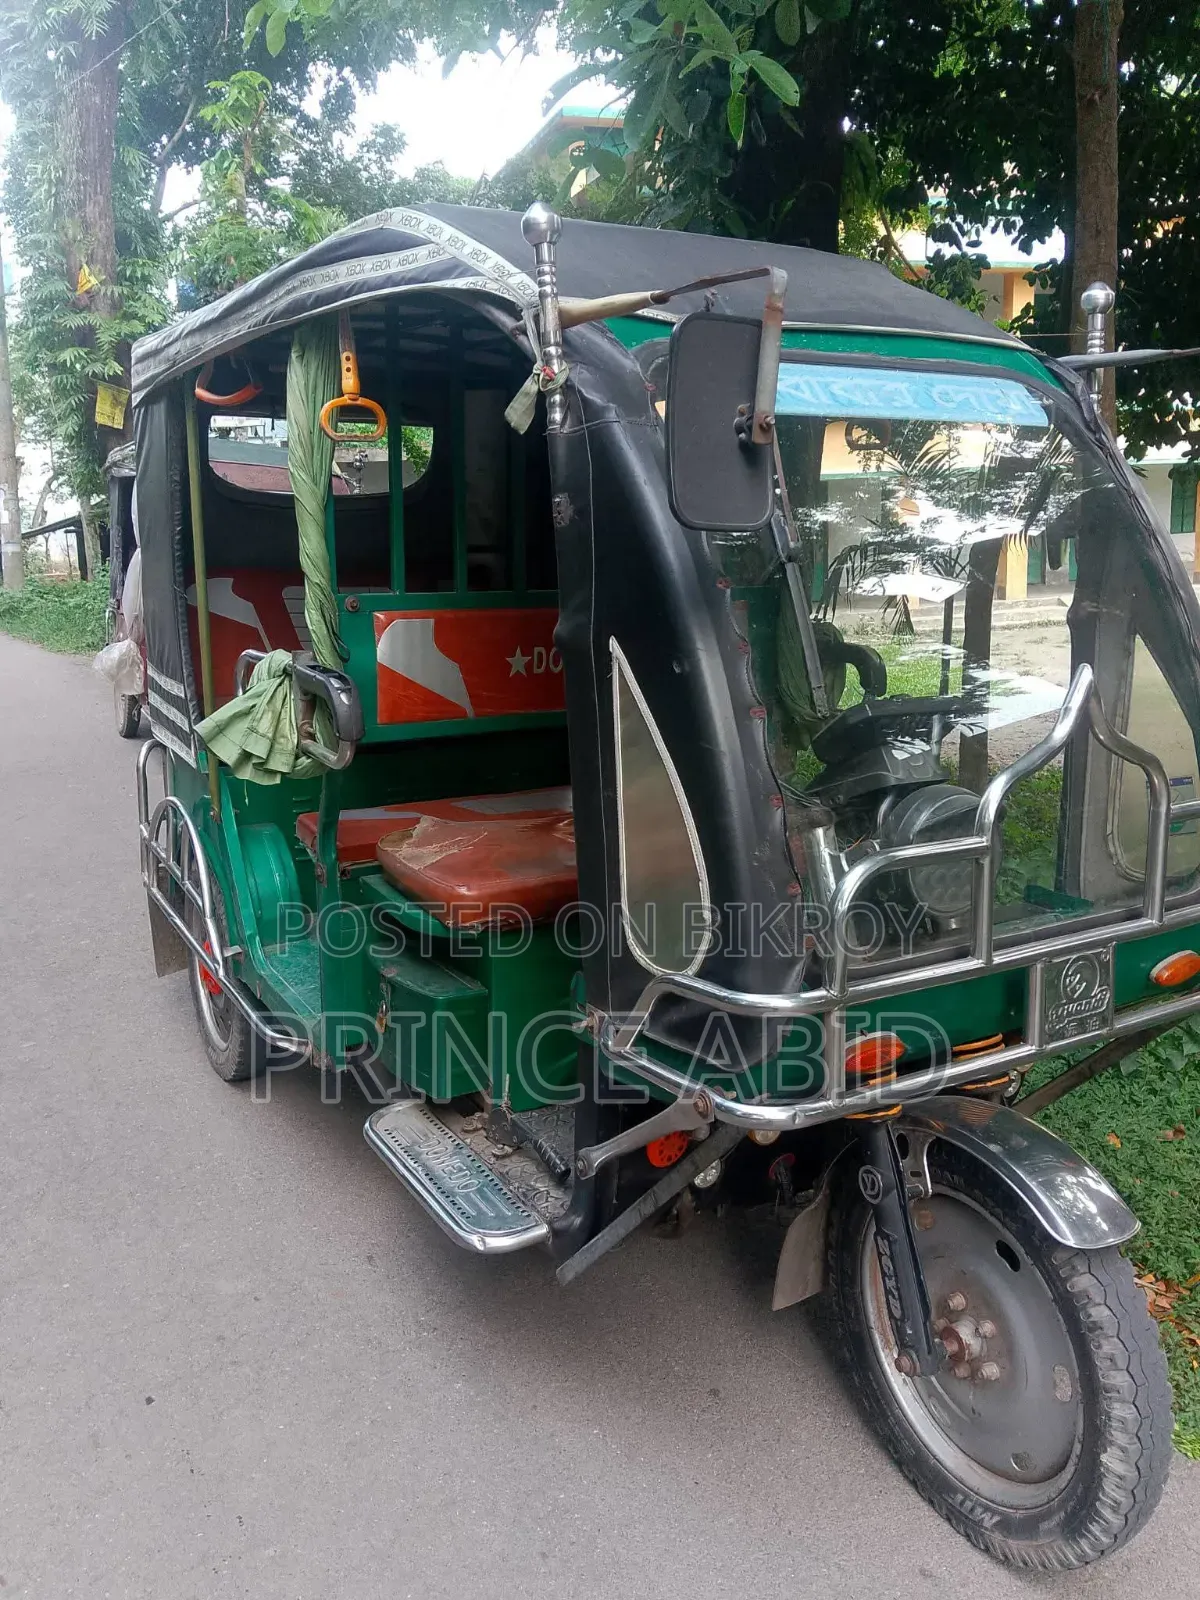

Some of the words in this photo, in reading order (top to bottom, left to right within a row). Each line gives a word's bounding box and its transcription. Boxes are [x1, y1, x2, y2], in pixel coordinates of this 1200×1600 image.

[320, 270, 340, 284] XBOX
[345, 262, 366, 277] XBOX
[369, 259, 392, 274] XBOX
[397, 253, 420, 268] XBOX
[426, 245, 447, 260] XBO
[398, 212, 424, 229] XBOX
[422, 222, 446, 240] XBOX
[446, 233, 469, 253] XBOX
[467, 246, 492, 266] XBOX
[490, 260, 515, 281] XBOX
[515, 280, 539, 300] XBOX
